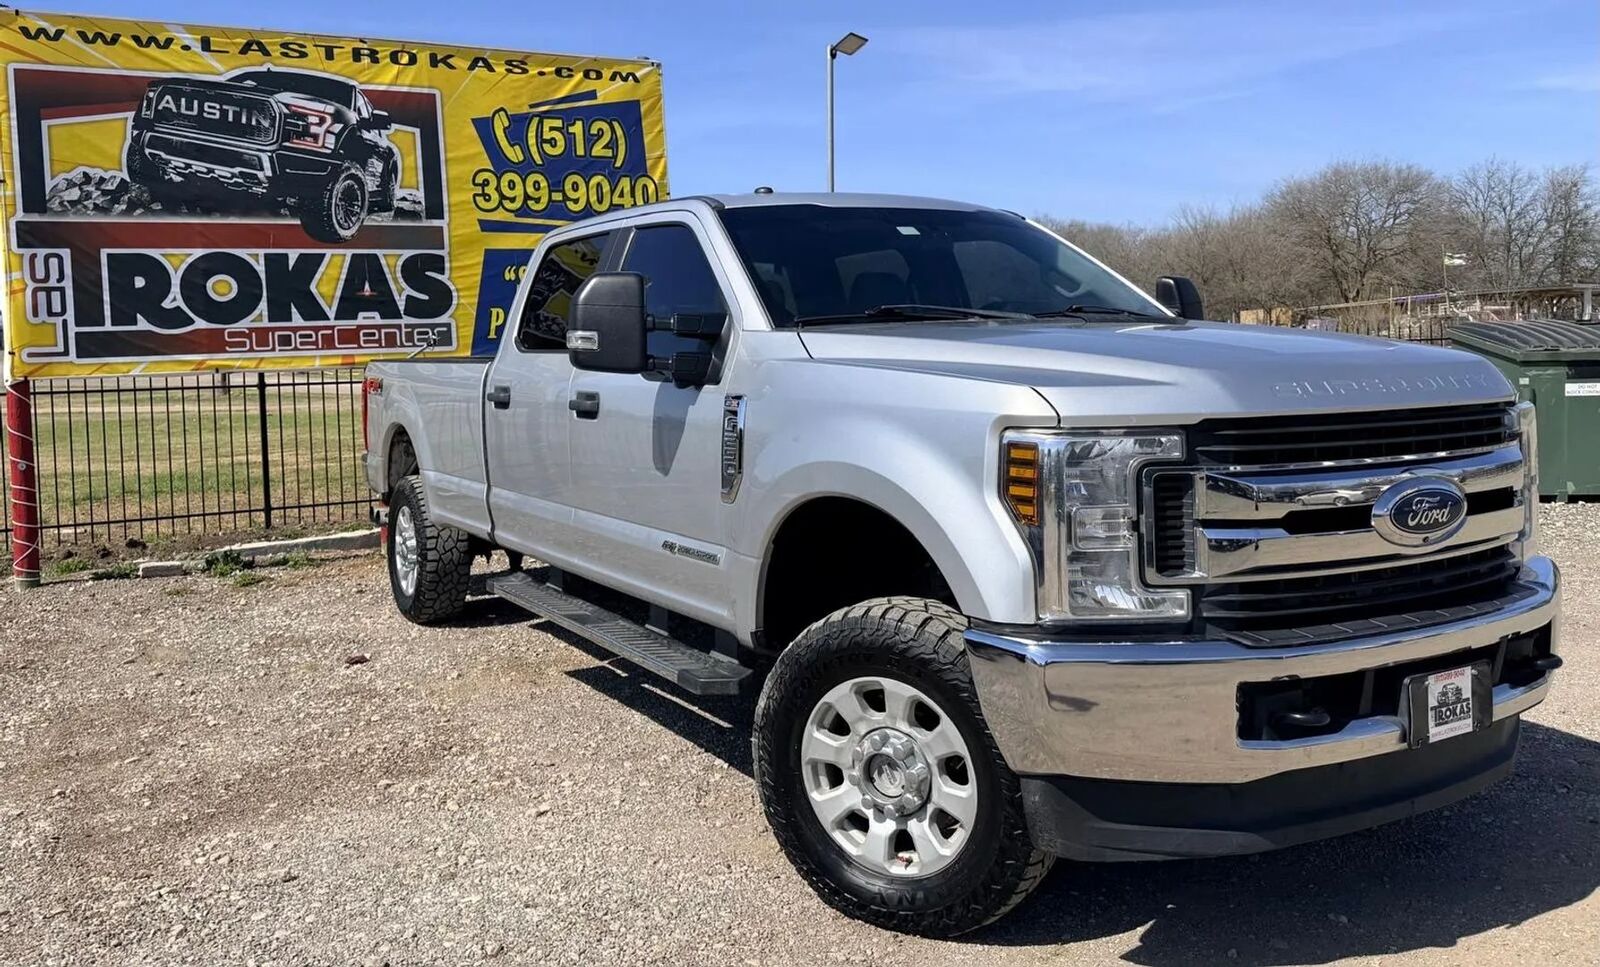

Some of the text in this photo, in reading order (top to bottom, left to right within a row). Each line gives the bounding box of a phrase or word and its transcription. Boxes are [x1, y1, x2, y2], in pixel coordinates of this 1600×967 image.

[157, 94, 271, 128] AUSTIN
[526, 114, 627, 168] (512)
[472, 168, 659, 214] 399-9040
[1407, 496, 1451, 527] Ford
